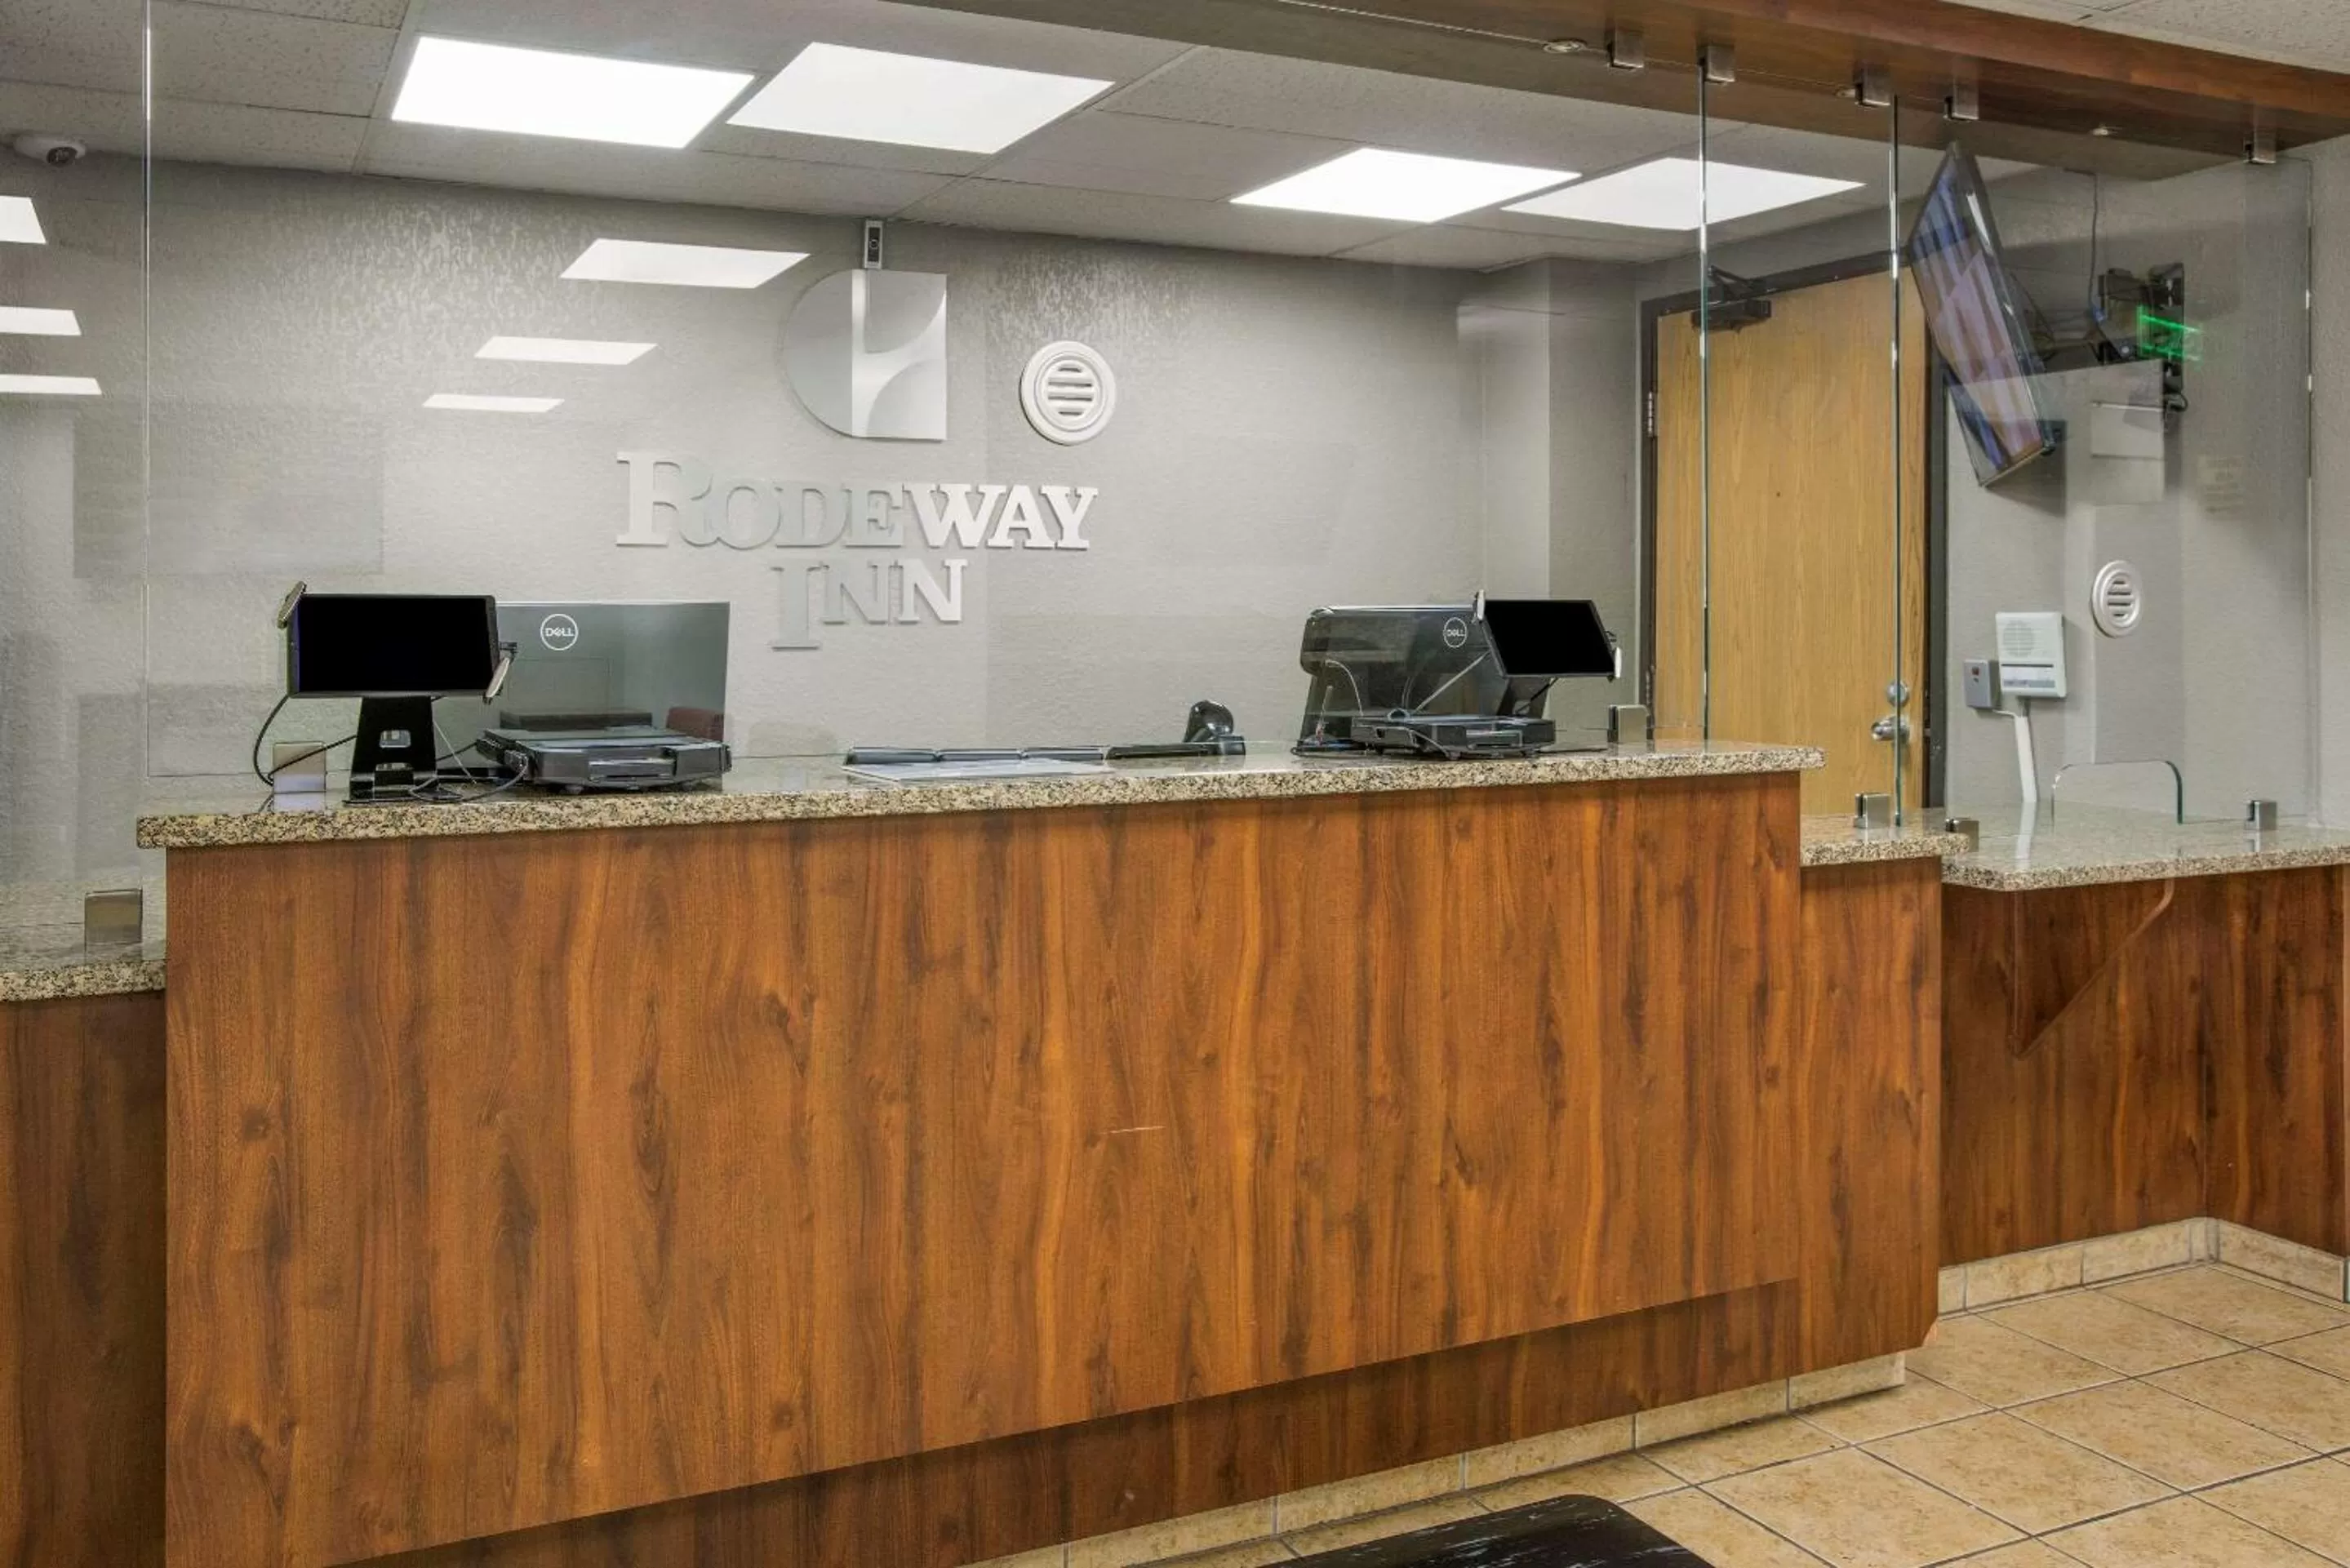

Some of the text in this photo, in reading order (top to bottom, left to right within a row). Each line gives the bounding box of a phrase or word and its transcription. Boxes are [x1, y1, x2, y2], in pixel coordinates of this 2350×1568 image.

[615, 451, 1098, 551] RODEWAY
[770, 559, 969, 652] INN
[544, 627, 575, 637] DELL
[1446, 629, 1467, 637] DELL
